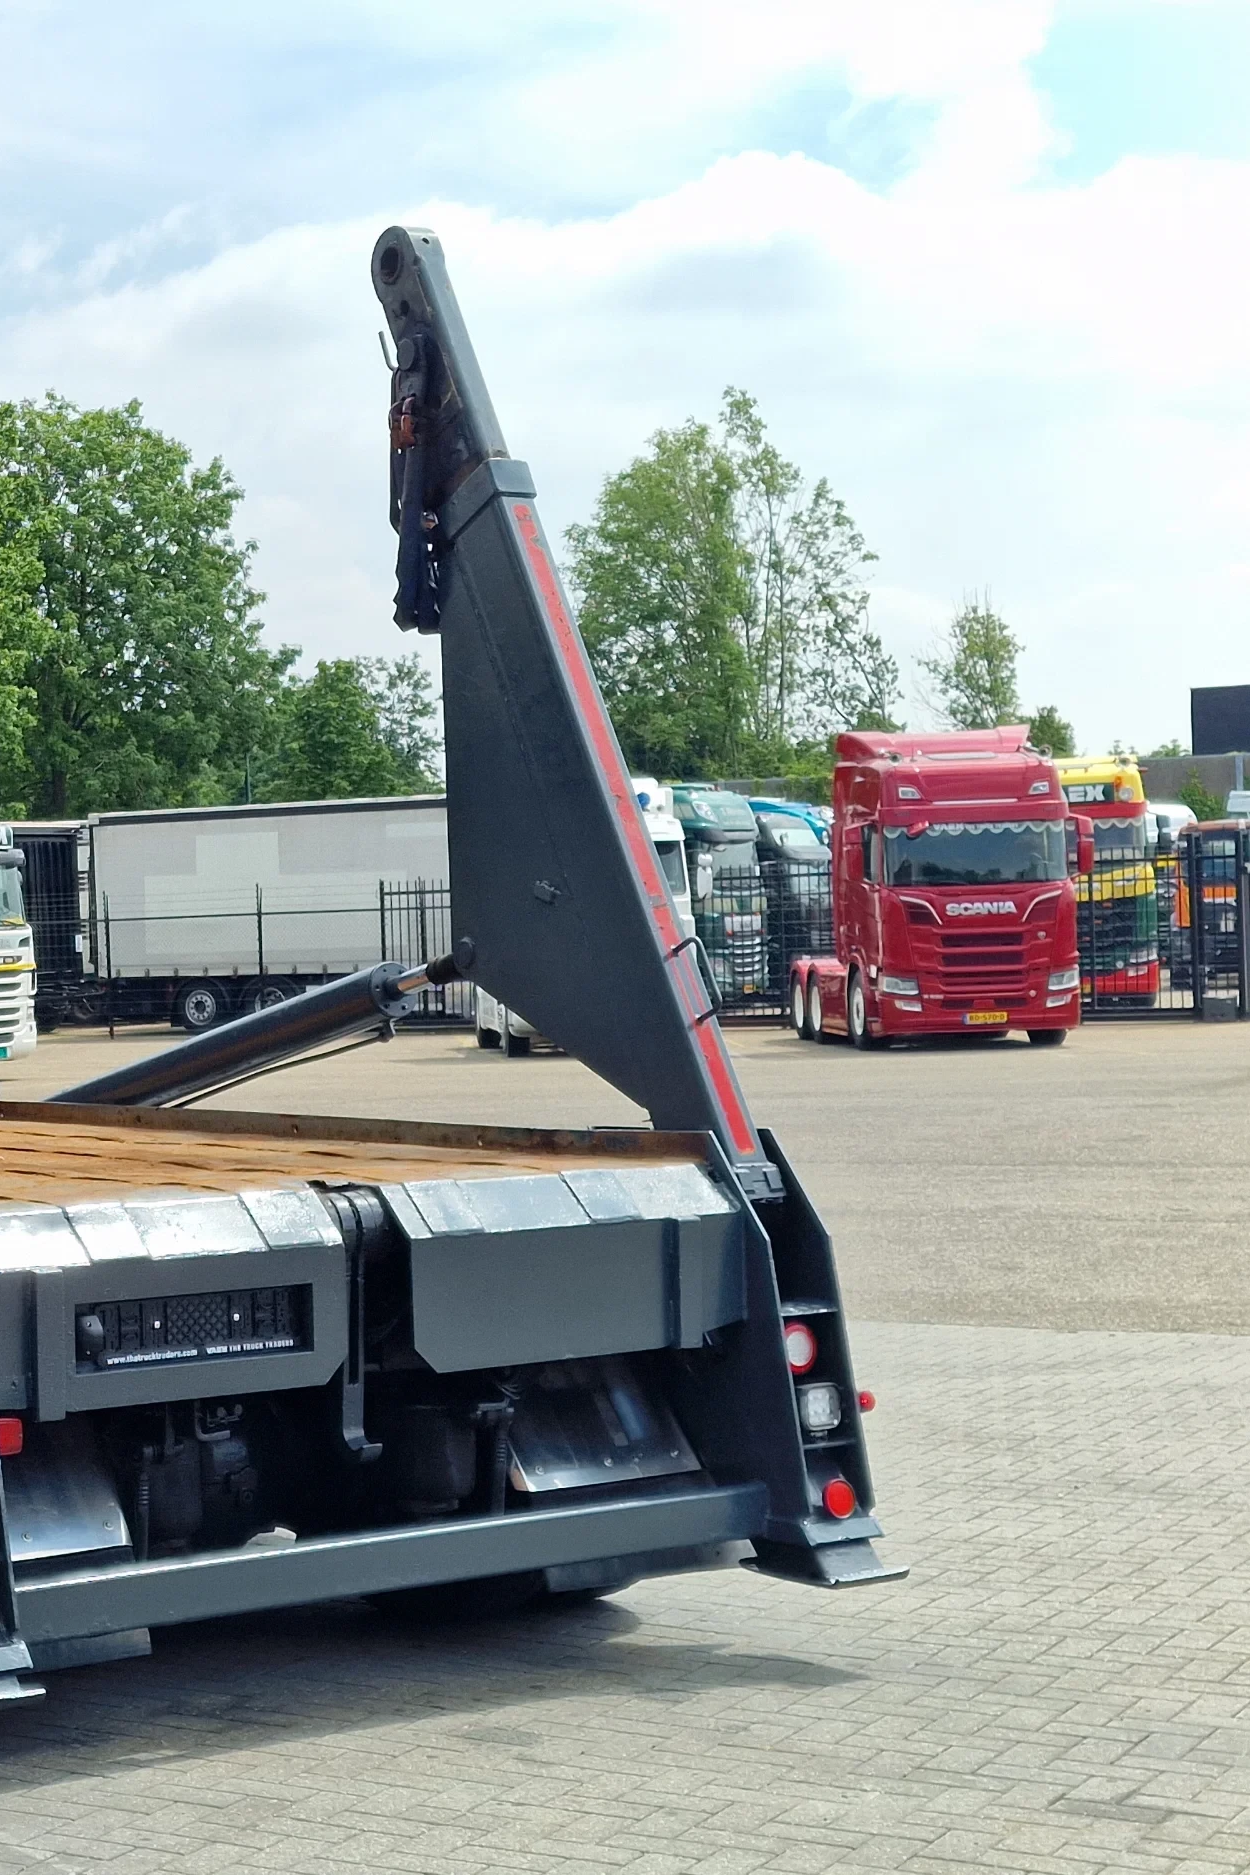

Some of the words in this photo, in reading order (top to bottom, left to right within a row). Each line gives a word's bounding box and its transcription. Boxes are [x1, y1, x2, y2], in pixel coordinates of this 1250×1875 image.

[1068, 784, 1105, 802] EX
[945, 901, 1018, 916] SCANIA
[243, 1342, 264, 1351] TRUCK
[265, 1339, 294, 1349] TRADERS
